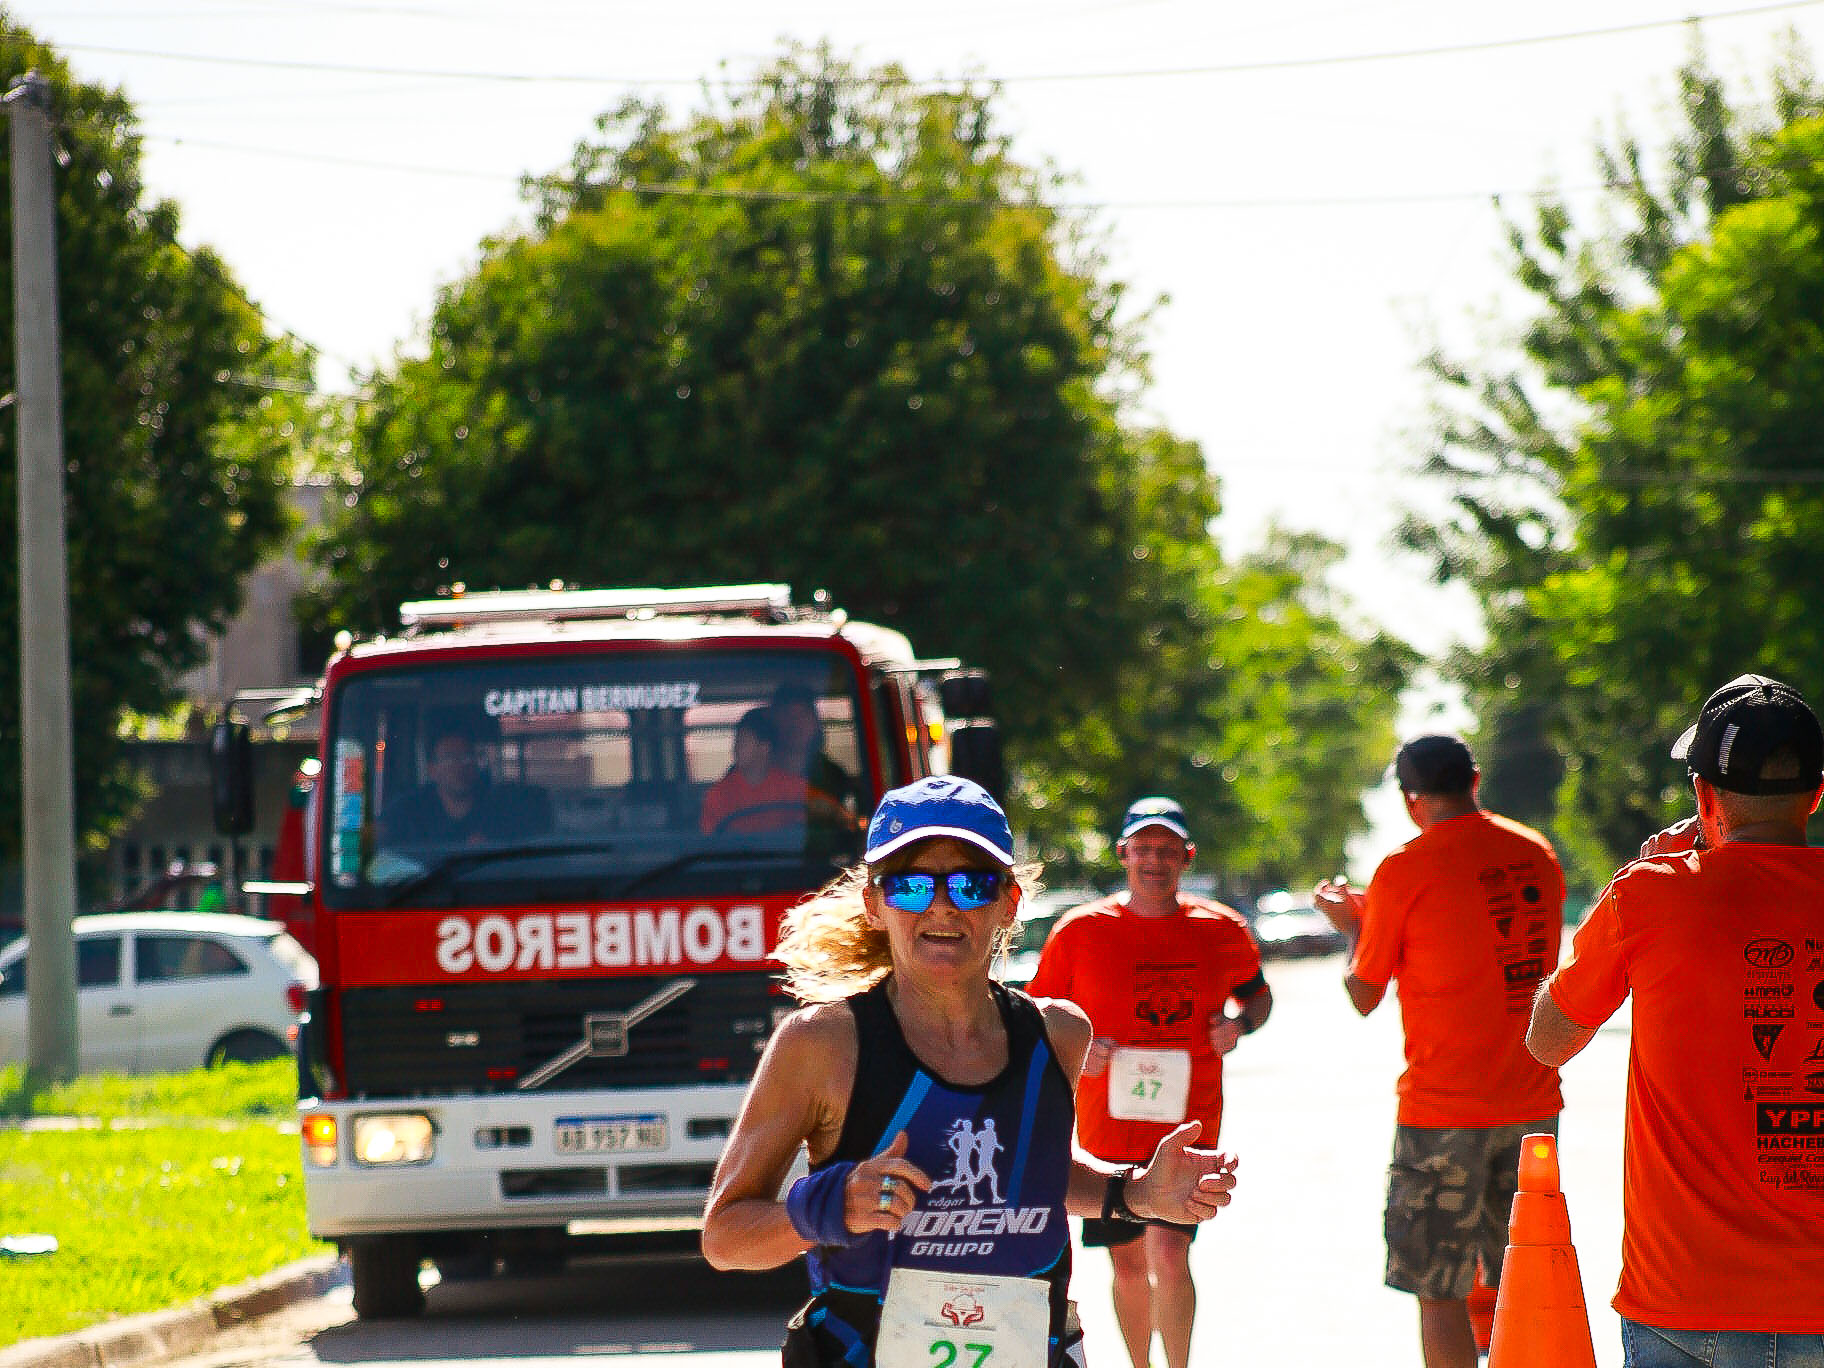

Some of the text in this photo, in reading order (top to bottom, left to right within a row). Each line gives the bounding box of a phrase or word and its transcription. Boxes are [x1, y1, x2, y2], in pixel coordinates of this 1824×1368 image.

[485, 680, 700, 716] CAPITAN BERMUDEZ
[1131, 1079, 1162, 1100] 47
[927, 1197, 966, 1210] edgar
[901, 1207, 1051, 1237] MORENO
